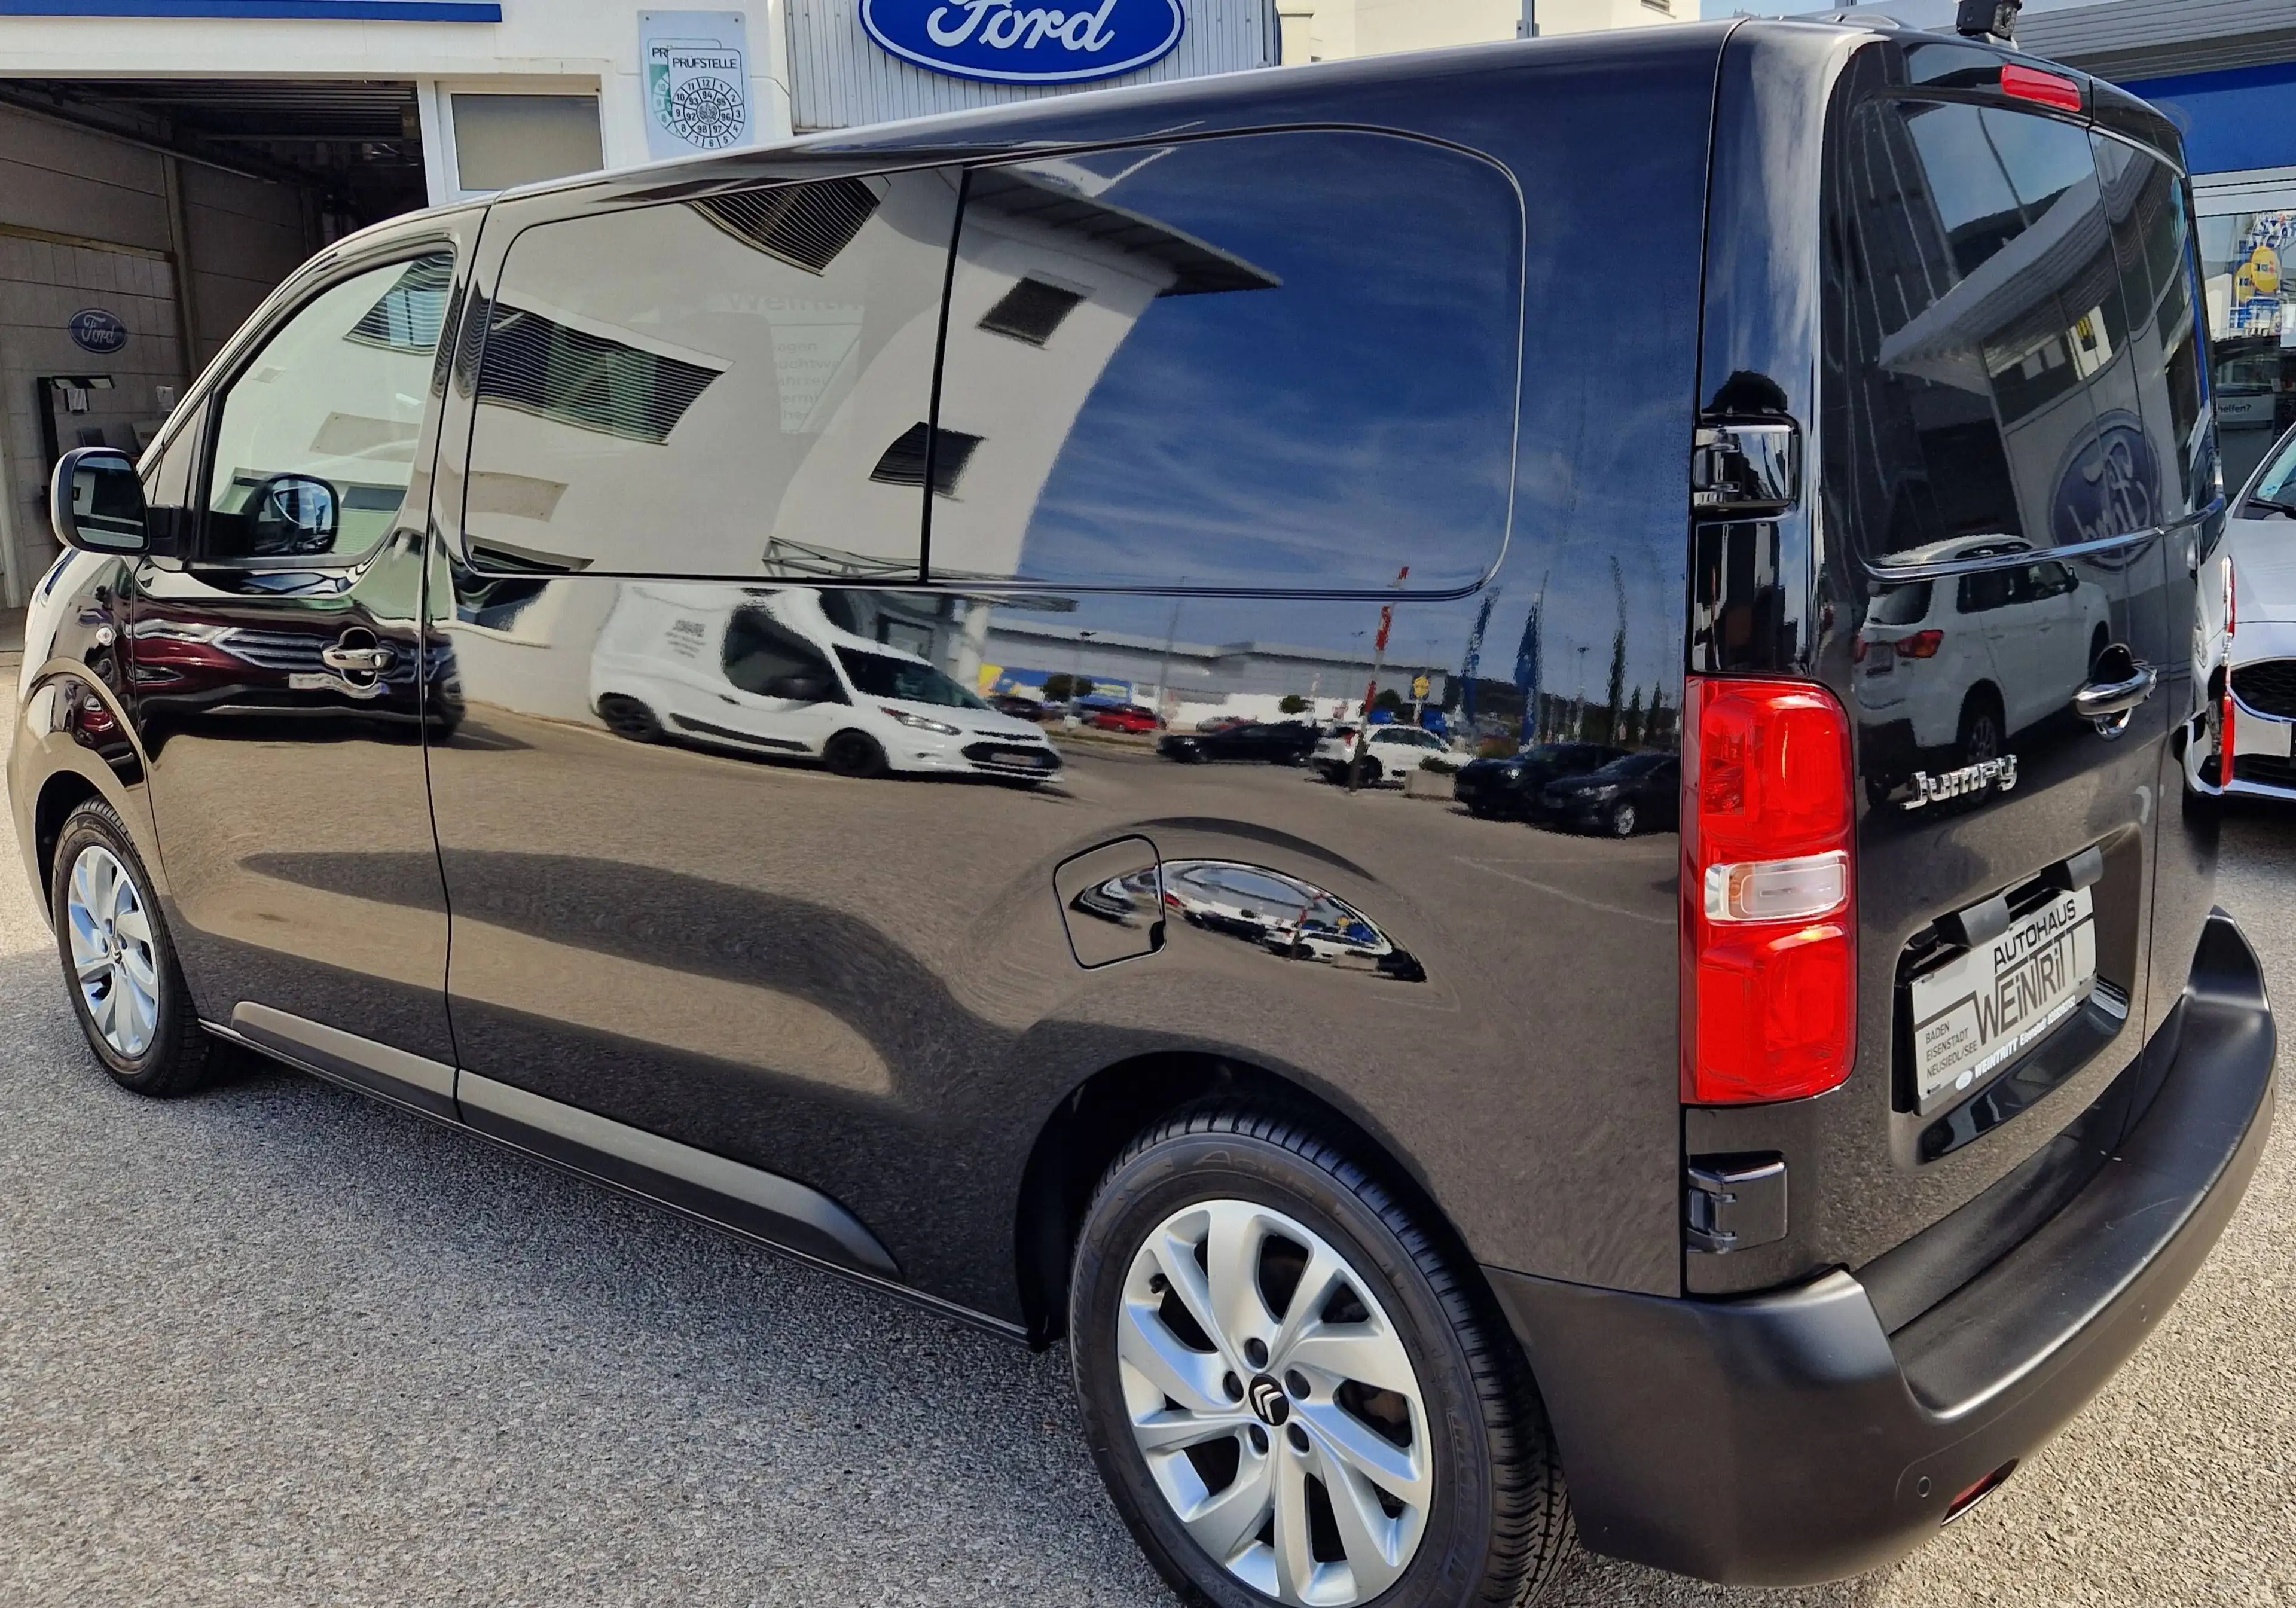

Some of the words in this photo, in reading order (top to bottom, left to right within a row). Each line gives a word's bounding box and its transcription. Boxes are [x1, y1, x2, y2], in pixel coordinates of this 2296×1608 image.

[927, 0, 1115, 52] Ford
[672, 55, 738, 69] PRÜFSTELLE
[702, 79, 710, 87] 12
[676, 93, 685, 102] 10
[701, 91, 713, 99] 94
[731, 94, 736, 102] 2
[689, 97, 698, 106] 93
[717, 97, 726, 106] 95
[676, 108, 680, 117] 9
[686, 112, 696, 121] 92
[721, 112, 731, 121] 96
[736, 109, 741, 118] 3
[681, 123, 686, 132] 8
[697, 124, 707, 133] 98
[713, 124, 722, 133] 97
[732, 124, 738, 132] 4
[694, 135, 699, 144] 7
[709, 138, 714, 147] 6
[723, 136, 728, 144] 5
[81, 315, 115, 344] Ford
[2218, 404, 2252, 413] helfen?
[1900, 753, 2017, 810] Jumpy
[1993, 898, 2077, 975] AUTOHAUS
[1925, 1020, 1950, 1045] BADEN
[1926, 1027, 1969, 1063] EISENSTADT
[1926, 1040, 1979, 1080] NEUSIEDL/SEE
